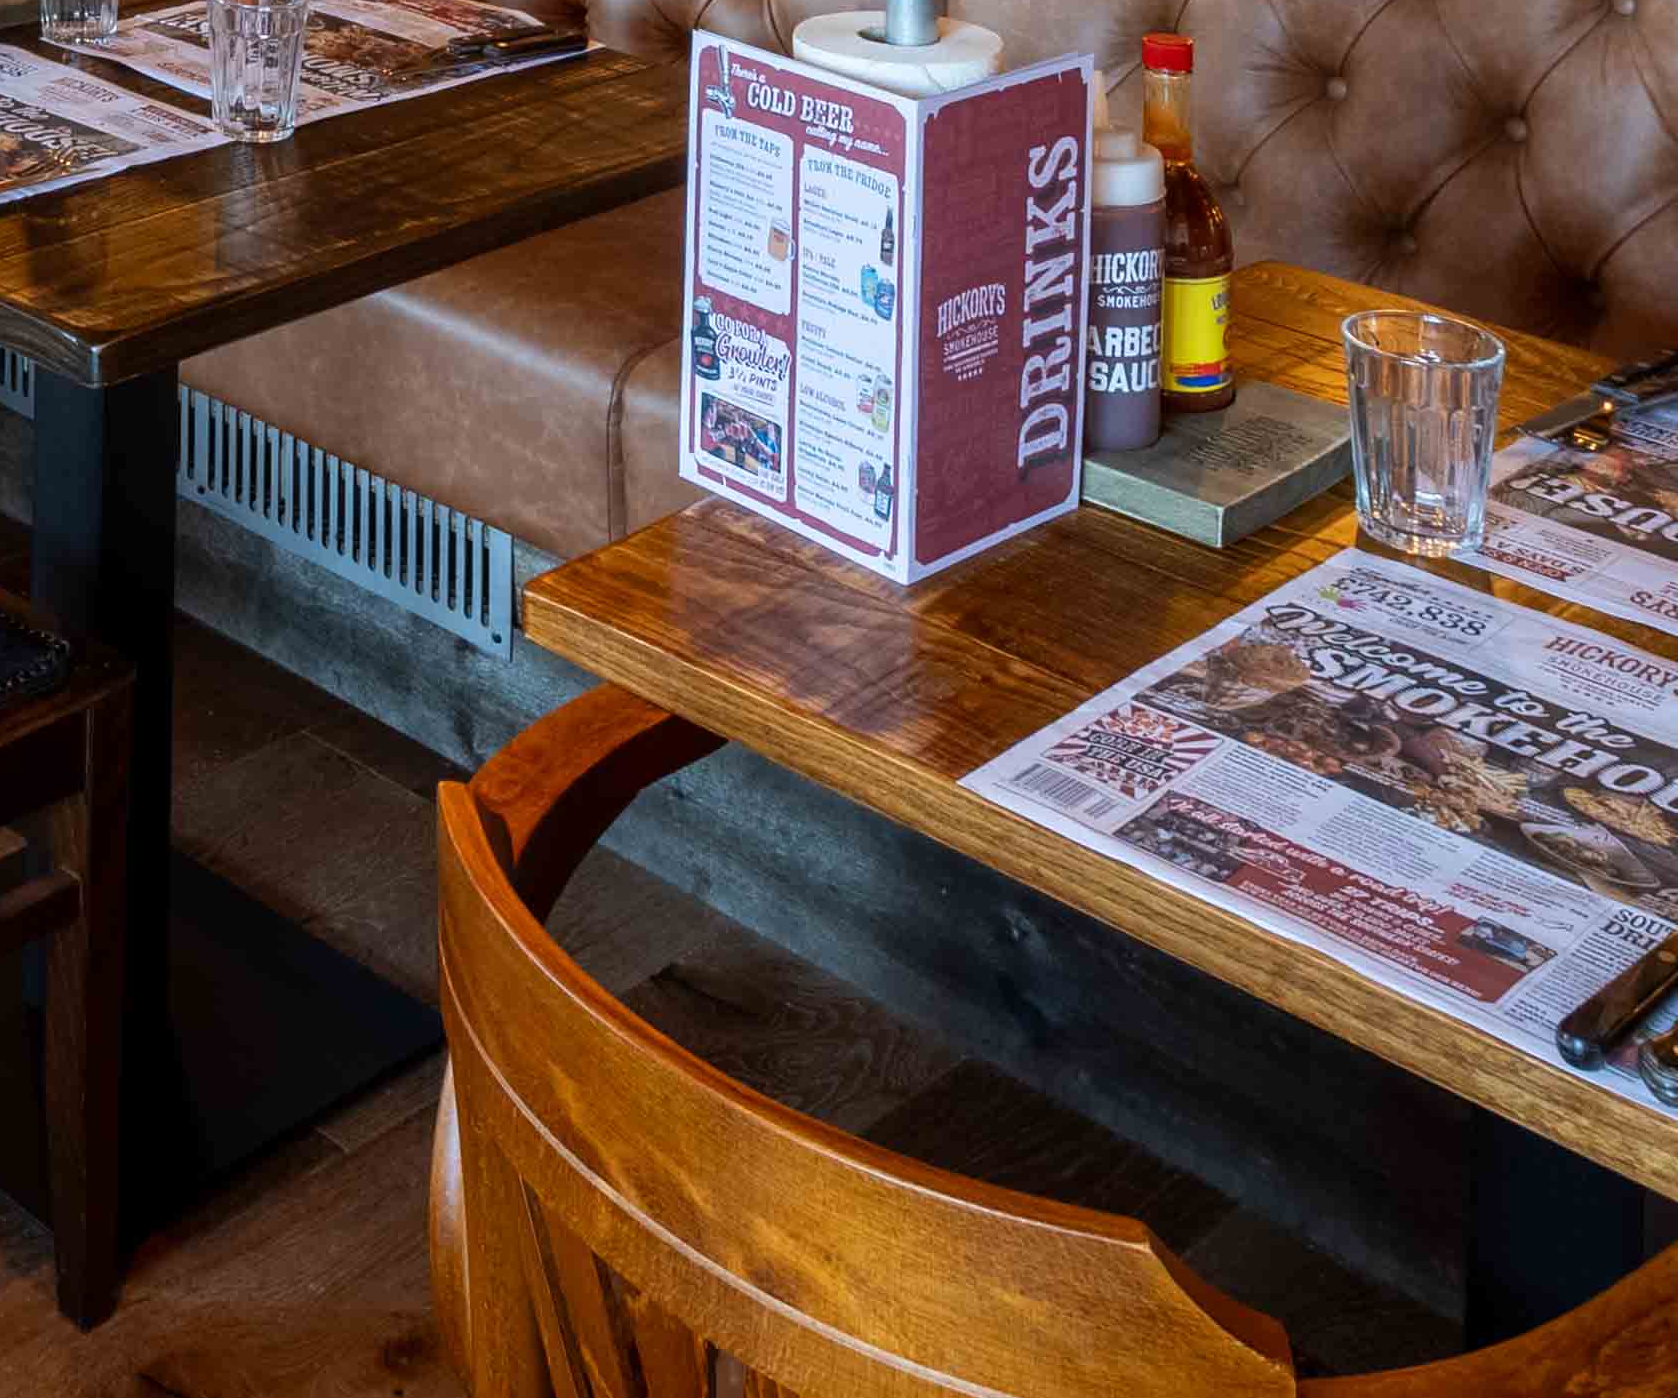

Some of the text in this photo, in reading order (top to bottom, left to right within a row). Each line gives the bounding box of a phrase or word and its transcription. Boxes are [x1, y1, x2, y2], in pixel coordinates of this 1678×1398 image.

[747, 82, 855, 135] COLD BEER
[714, 124, 781, 157] FROM THE TAPS
[805, 125, 839, 148] calling
[837, 133, 855, 151] my
[807, 159, 892, 199] FROM THE FRIDGE
[1018, 135, 1080, 470] DRINKS
[716, 332, 791, 381] Growler!
[943, 324, 999, 356] SMOKEHOUSE
[749, 372, 778, 392] PINTS
[1266, 603, 1490, 698] Welcome
[1493, 687, 1550, 720] to
[1555, 709, 1639, 750] the
[1087, 744, 1166, 780] THE USA
[1219, 820, 1291, 851] started
[1348, 873, 1407, 898] road
